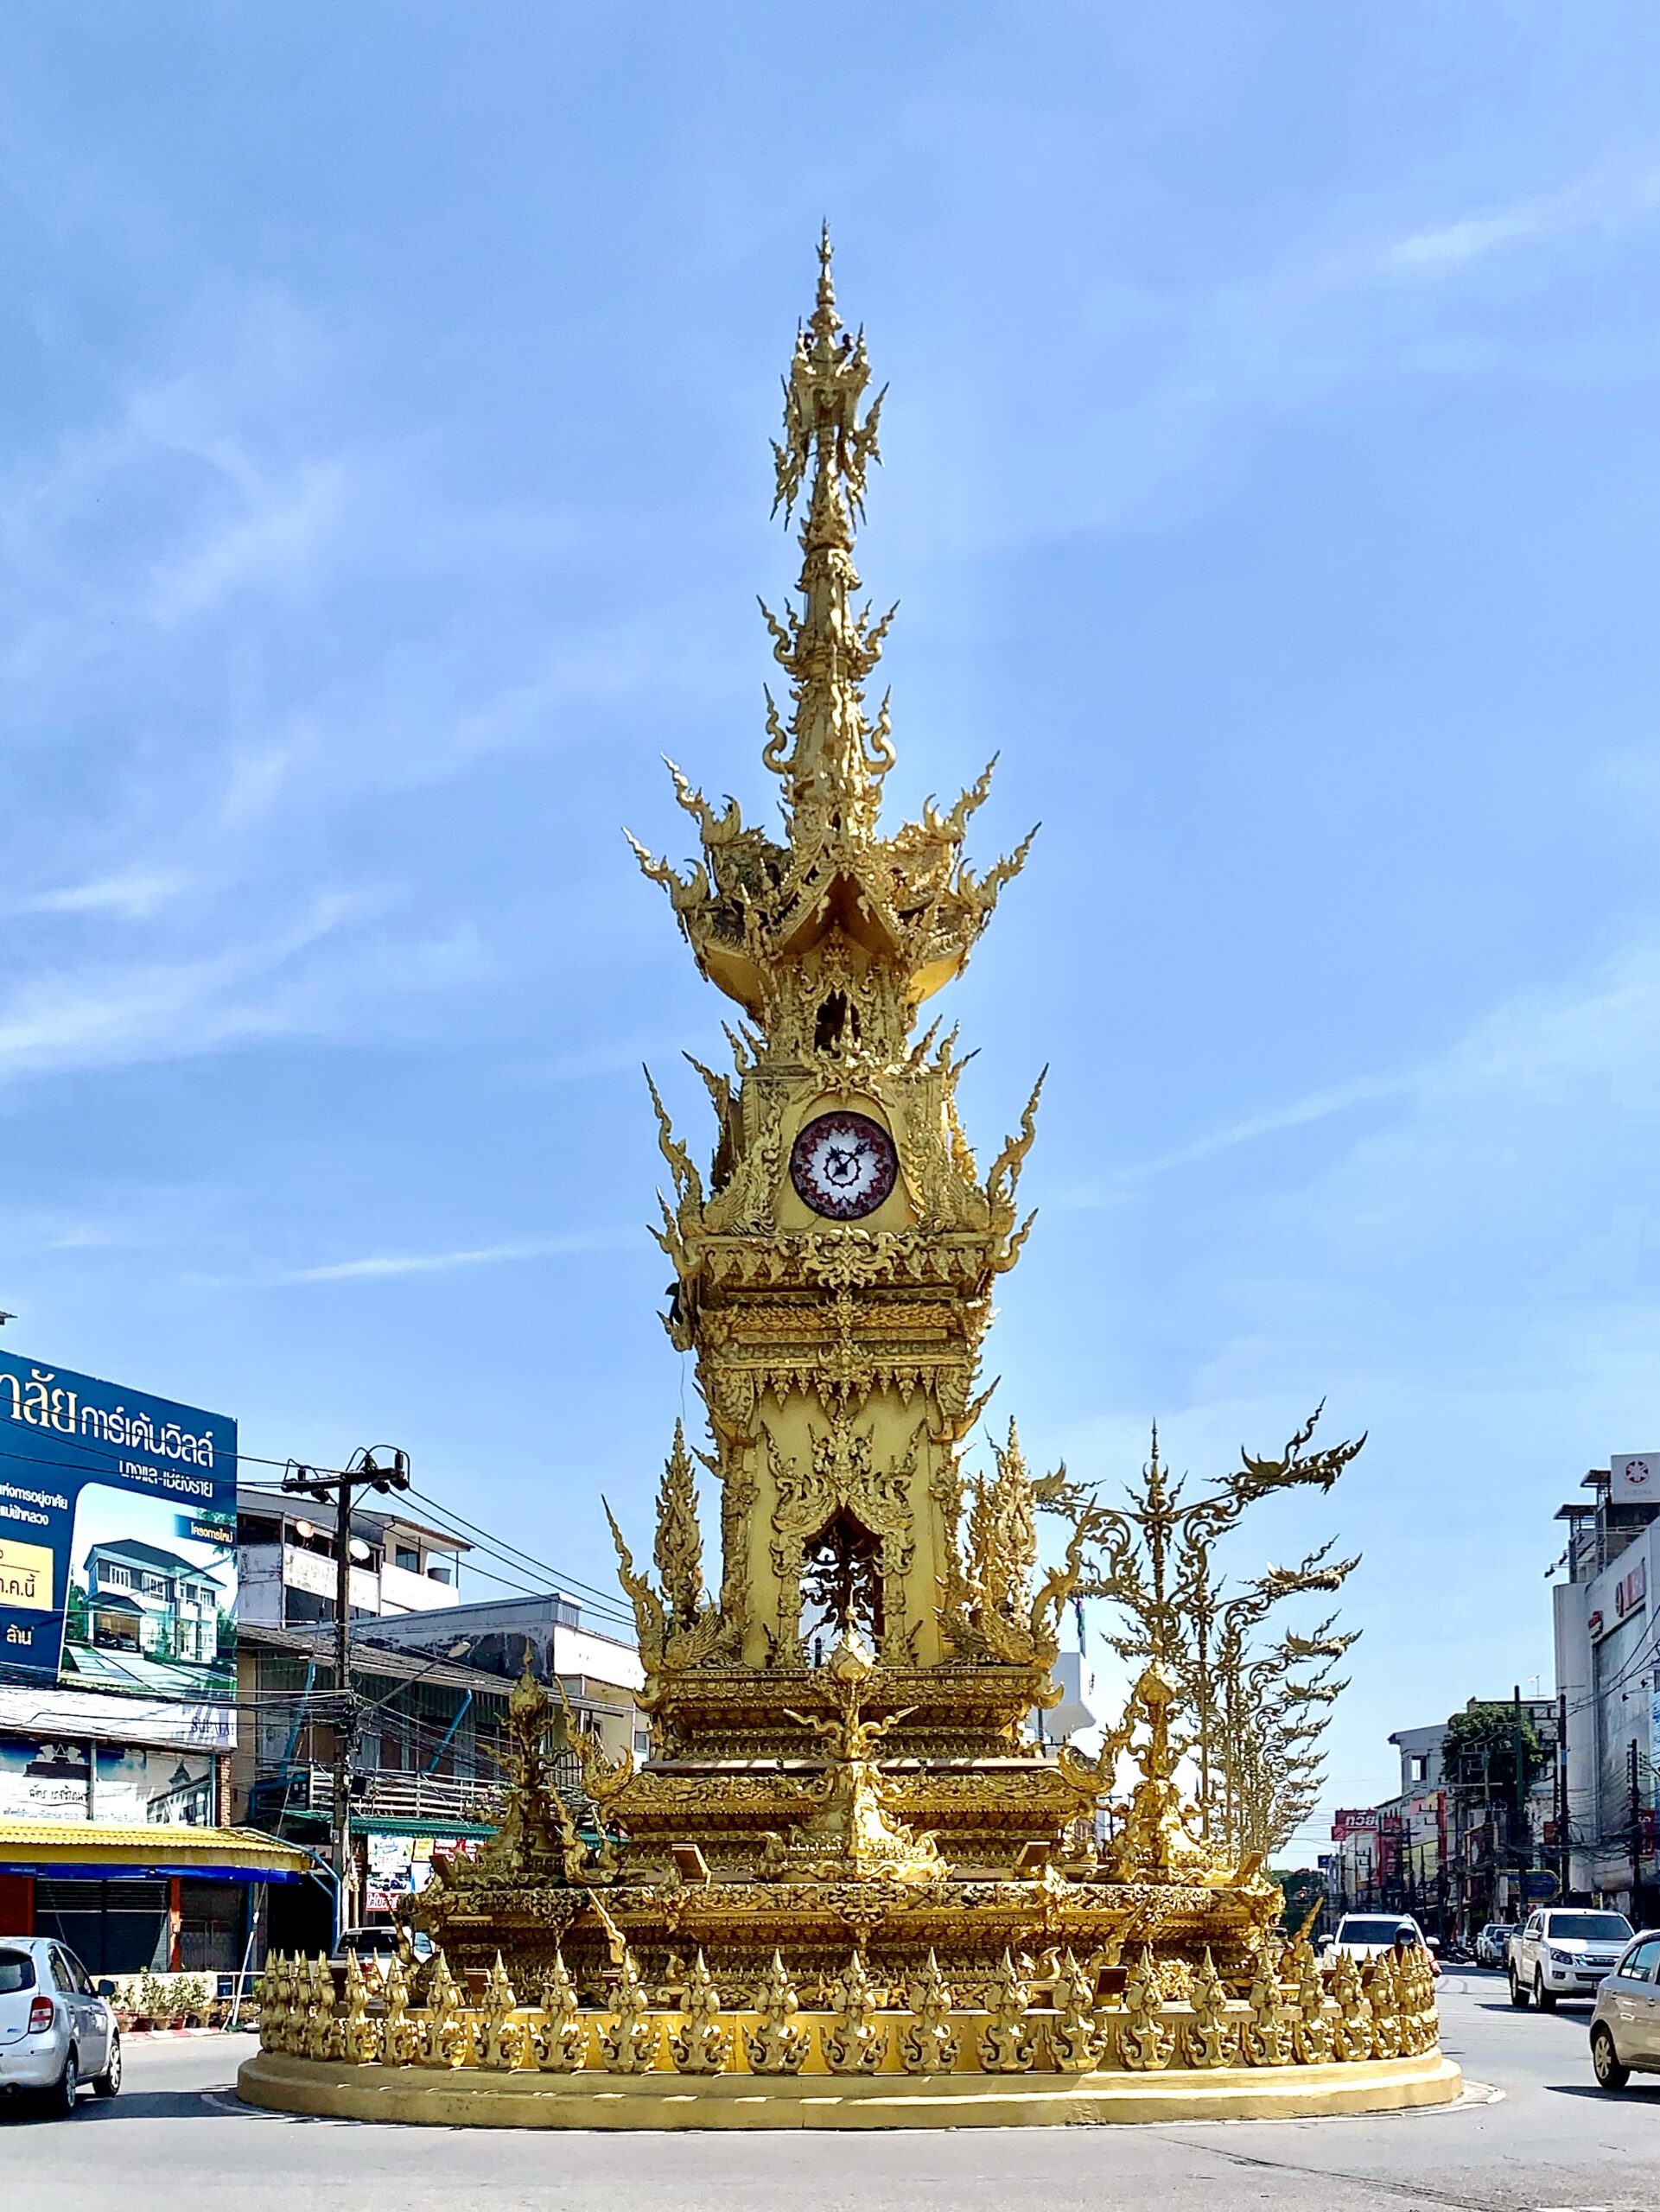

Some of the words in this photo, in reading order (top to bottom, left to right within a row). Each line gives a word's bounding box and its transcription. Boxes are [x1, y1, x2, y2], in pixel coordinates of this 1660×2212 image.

[81, 1406, 213, 1468] การ์เด้นวิลล์
[191, 1522, 233, 1544] โครงการใหม่
